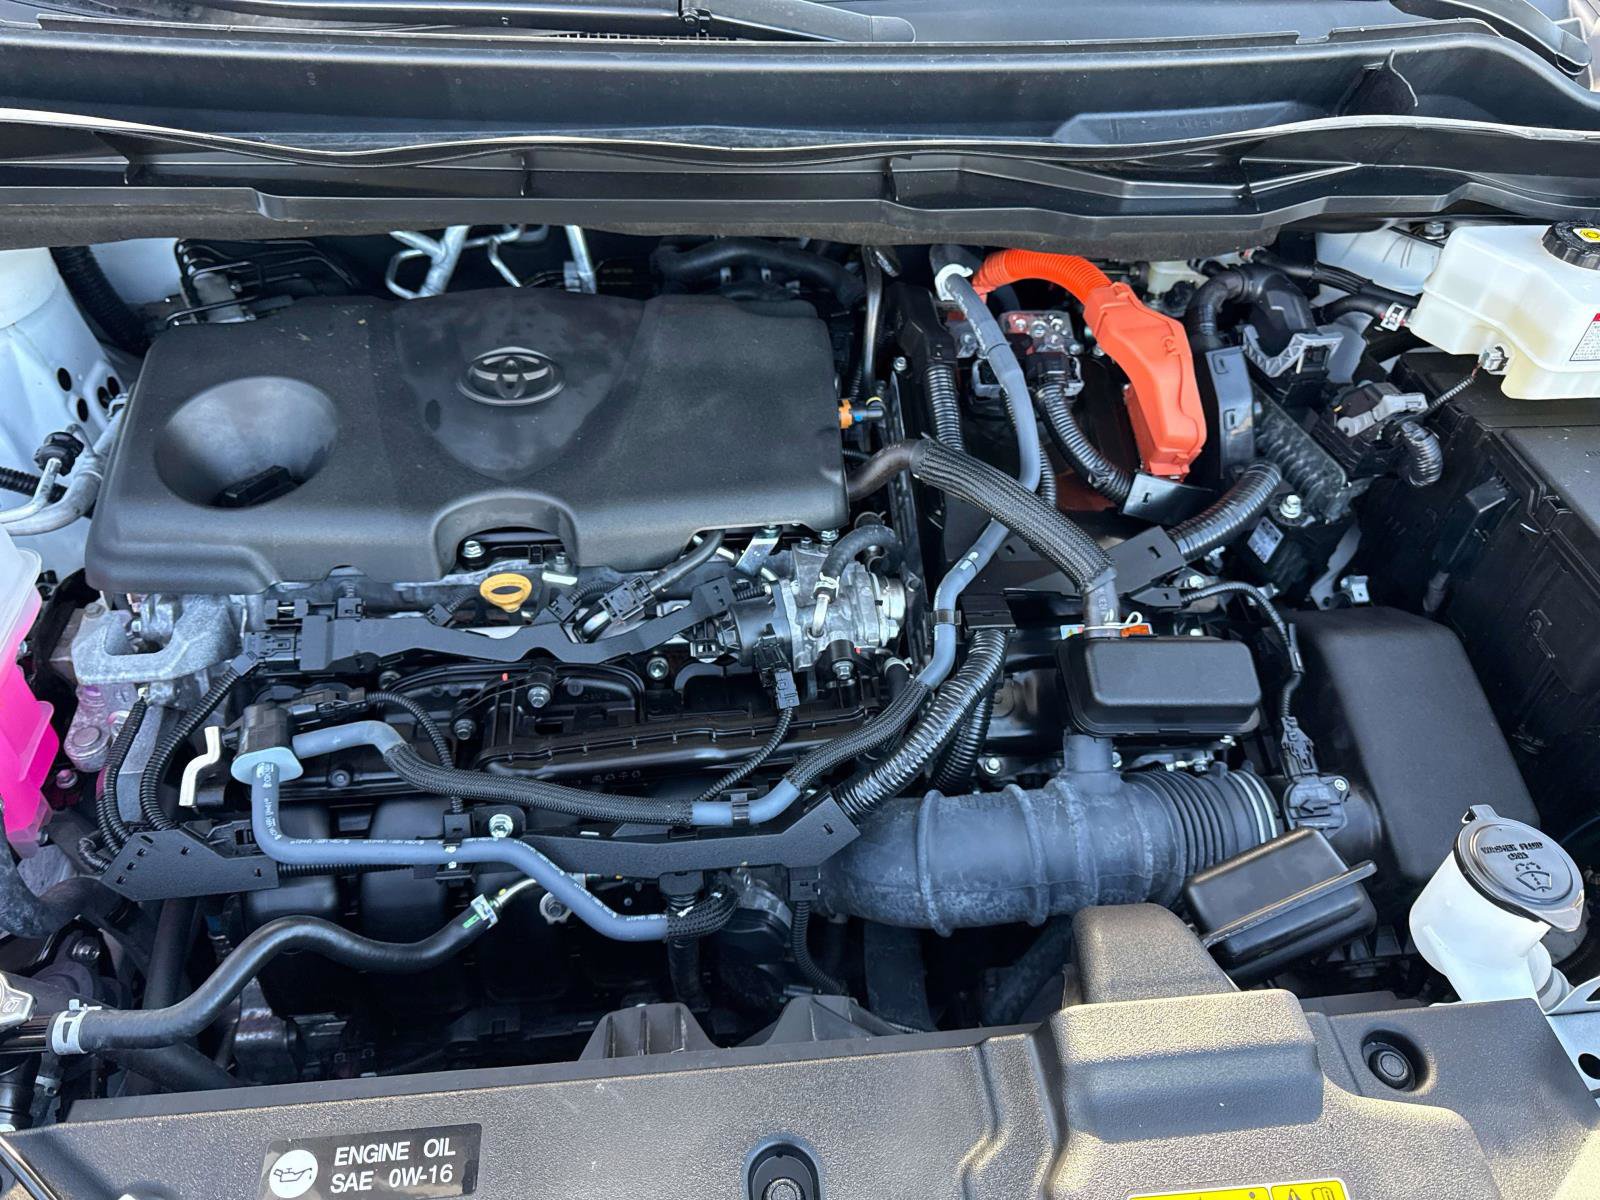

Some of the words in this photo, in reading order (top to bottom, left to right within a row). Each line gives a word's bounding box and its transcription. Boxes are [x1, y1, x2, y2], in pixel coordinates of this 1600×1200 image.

[334, 1141, 411, 1167] ENGINE
[423, 1138, 456, 1159] OIL
[330, 1170, 374, 1193] SAE
[388, 1163, 453, 1188] 0W-16
